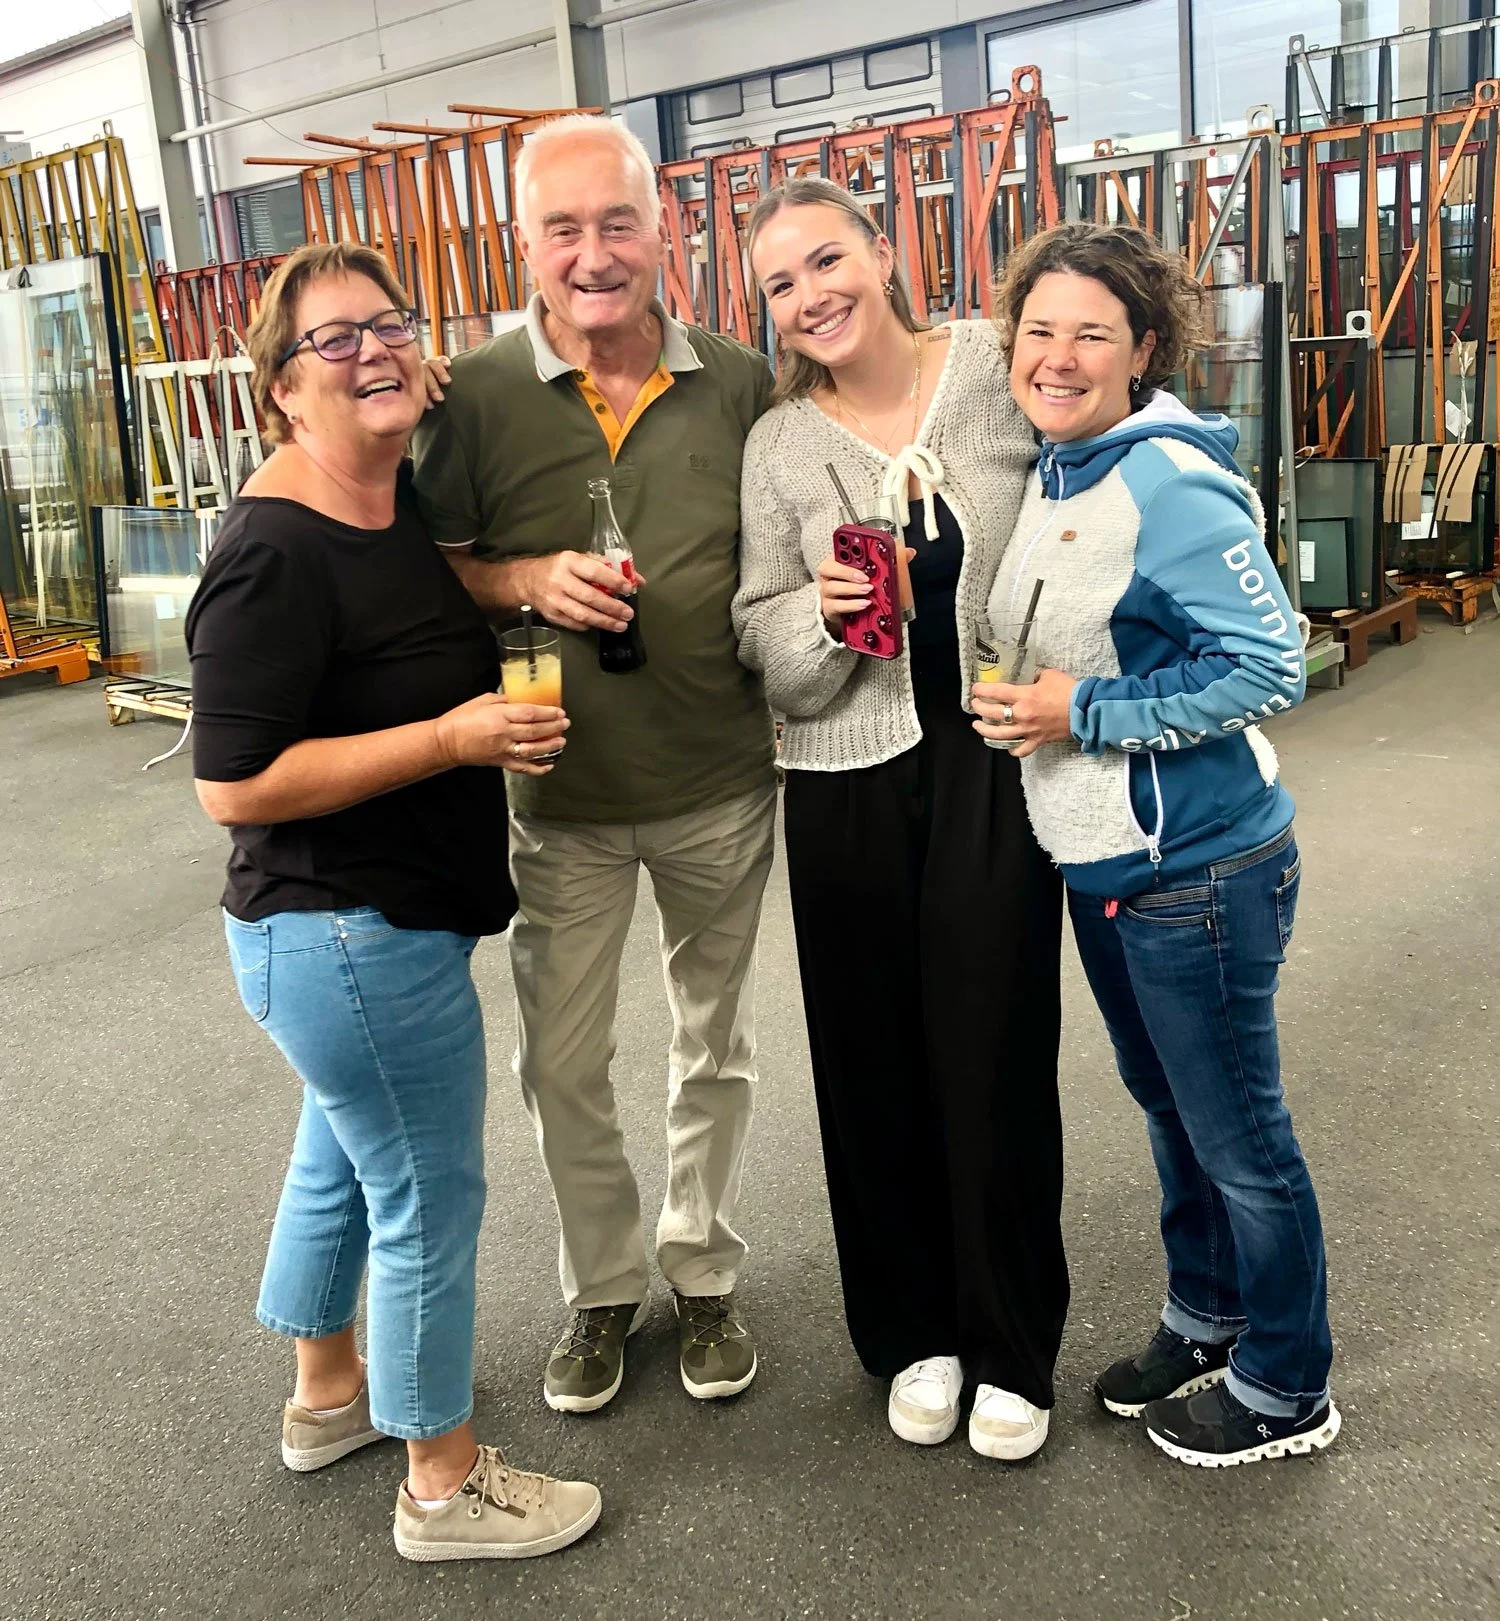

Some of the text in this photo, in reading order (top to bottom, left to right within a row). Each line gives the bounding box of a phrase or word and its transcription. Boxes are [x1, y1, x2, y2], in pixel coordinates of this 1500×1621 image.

[1222, 538, 1288, 638] born
[1280, 647, 1303, 684] in
[1120, 722, 1207, 753] Alps
